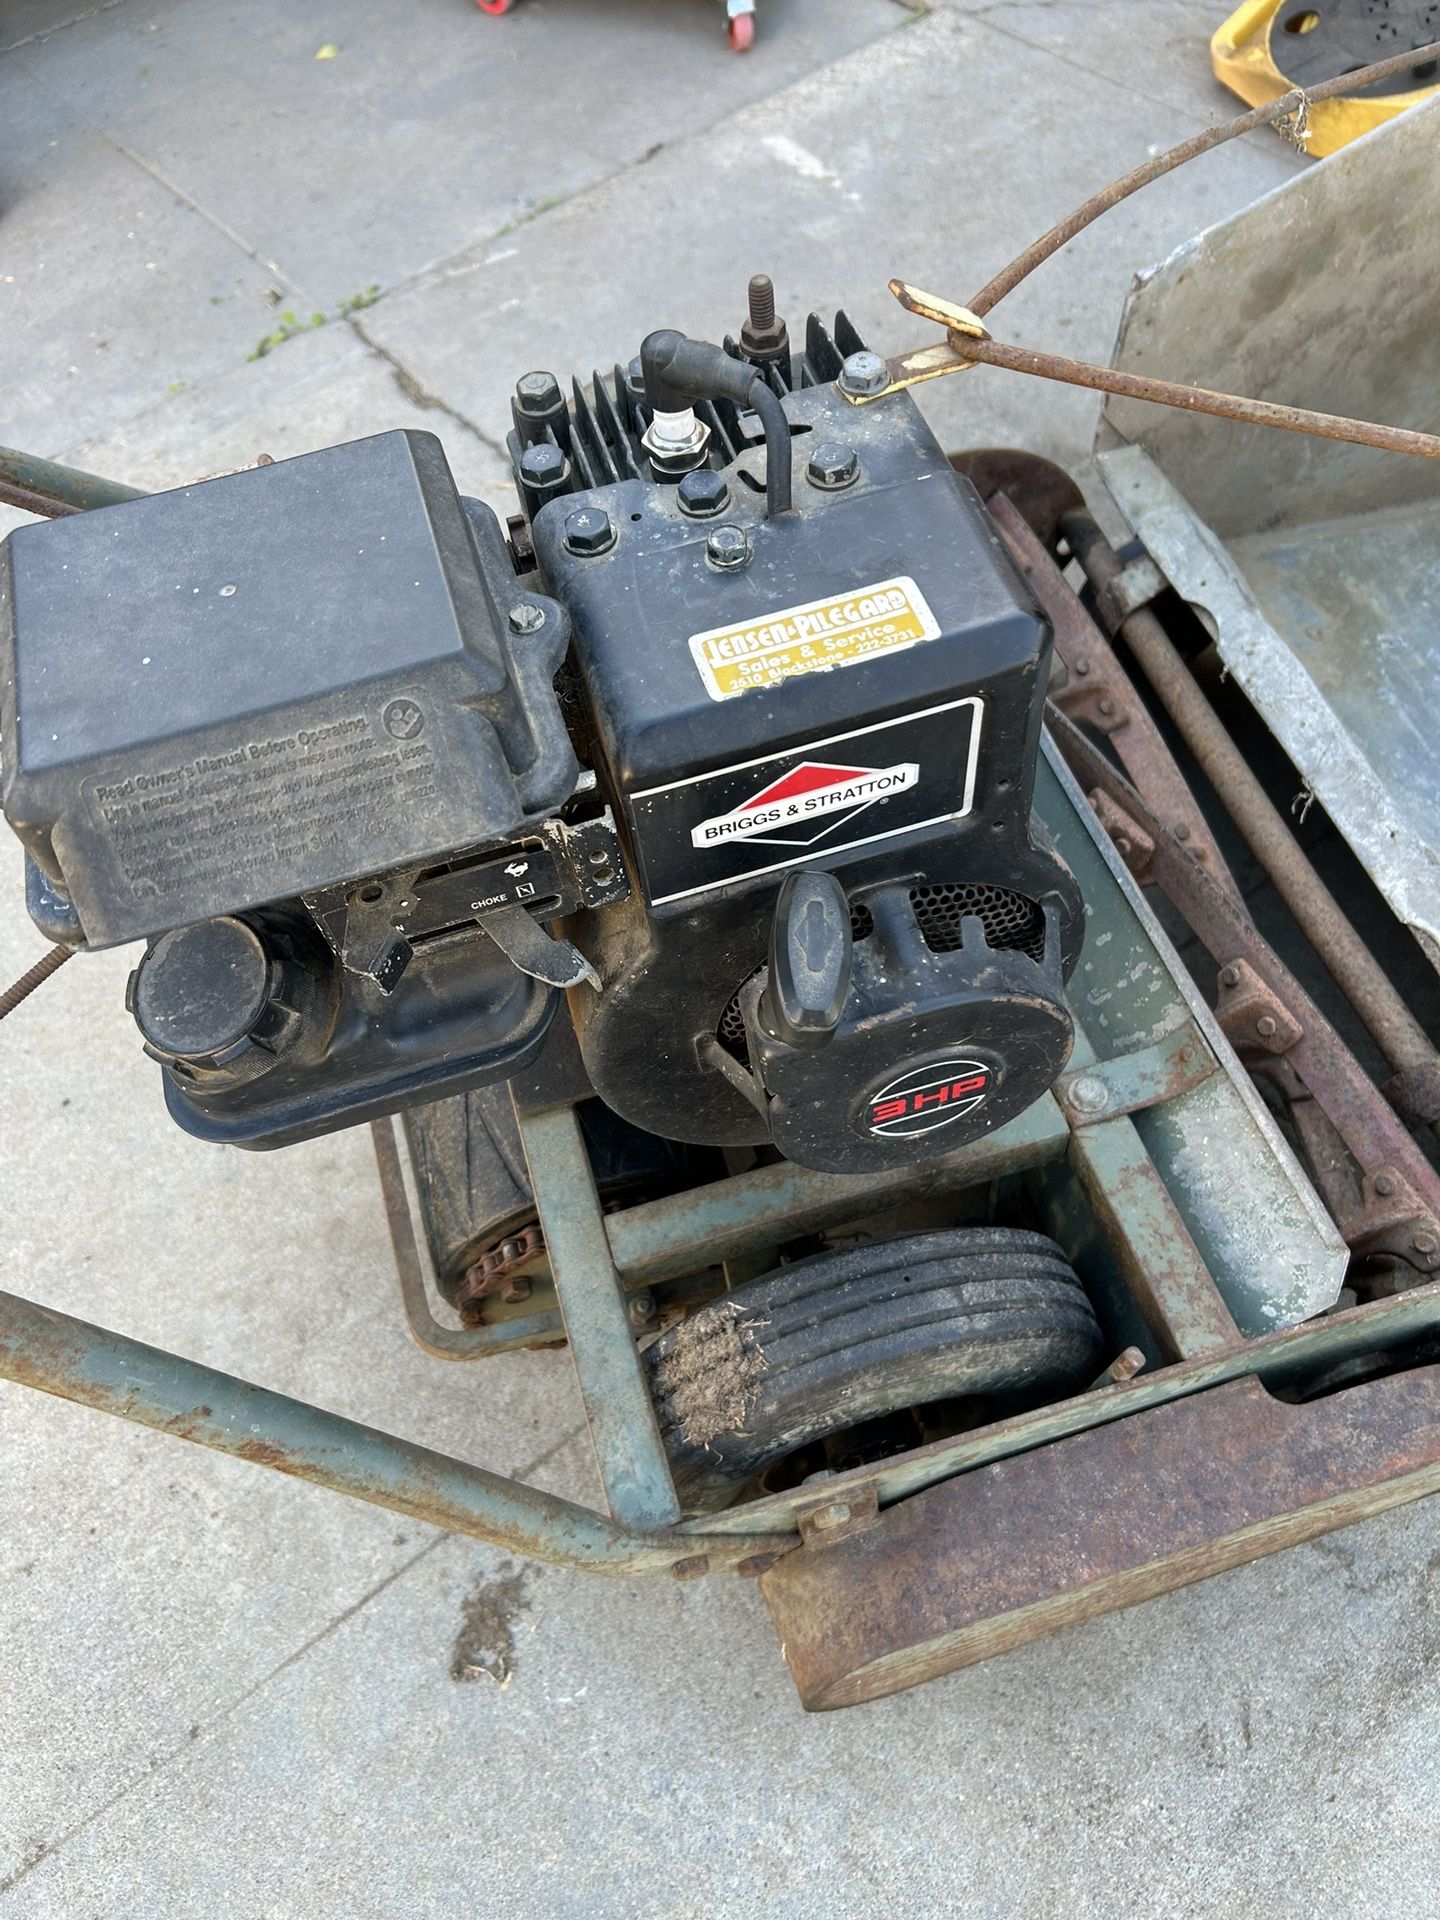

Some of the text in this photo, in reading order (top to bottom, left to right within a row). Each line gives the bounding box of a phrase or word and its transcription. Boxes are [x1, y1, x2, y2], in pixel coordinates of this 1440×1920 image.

[729, 674, 763, 690] 2610
[768, 651, 844, 679] Blackstone
[856, 630, 915, 654] 222-3731
[736, 623, 896, 676] Sales & Service
[96, 717, 370, 801] Read Owner's Manual Before Operating.
[705, 772, 906, 840] BRIGGS & STRATTON
[470, 893, 508, 910] CHOKE
